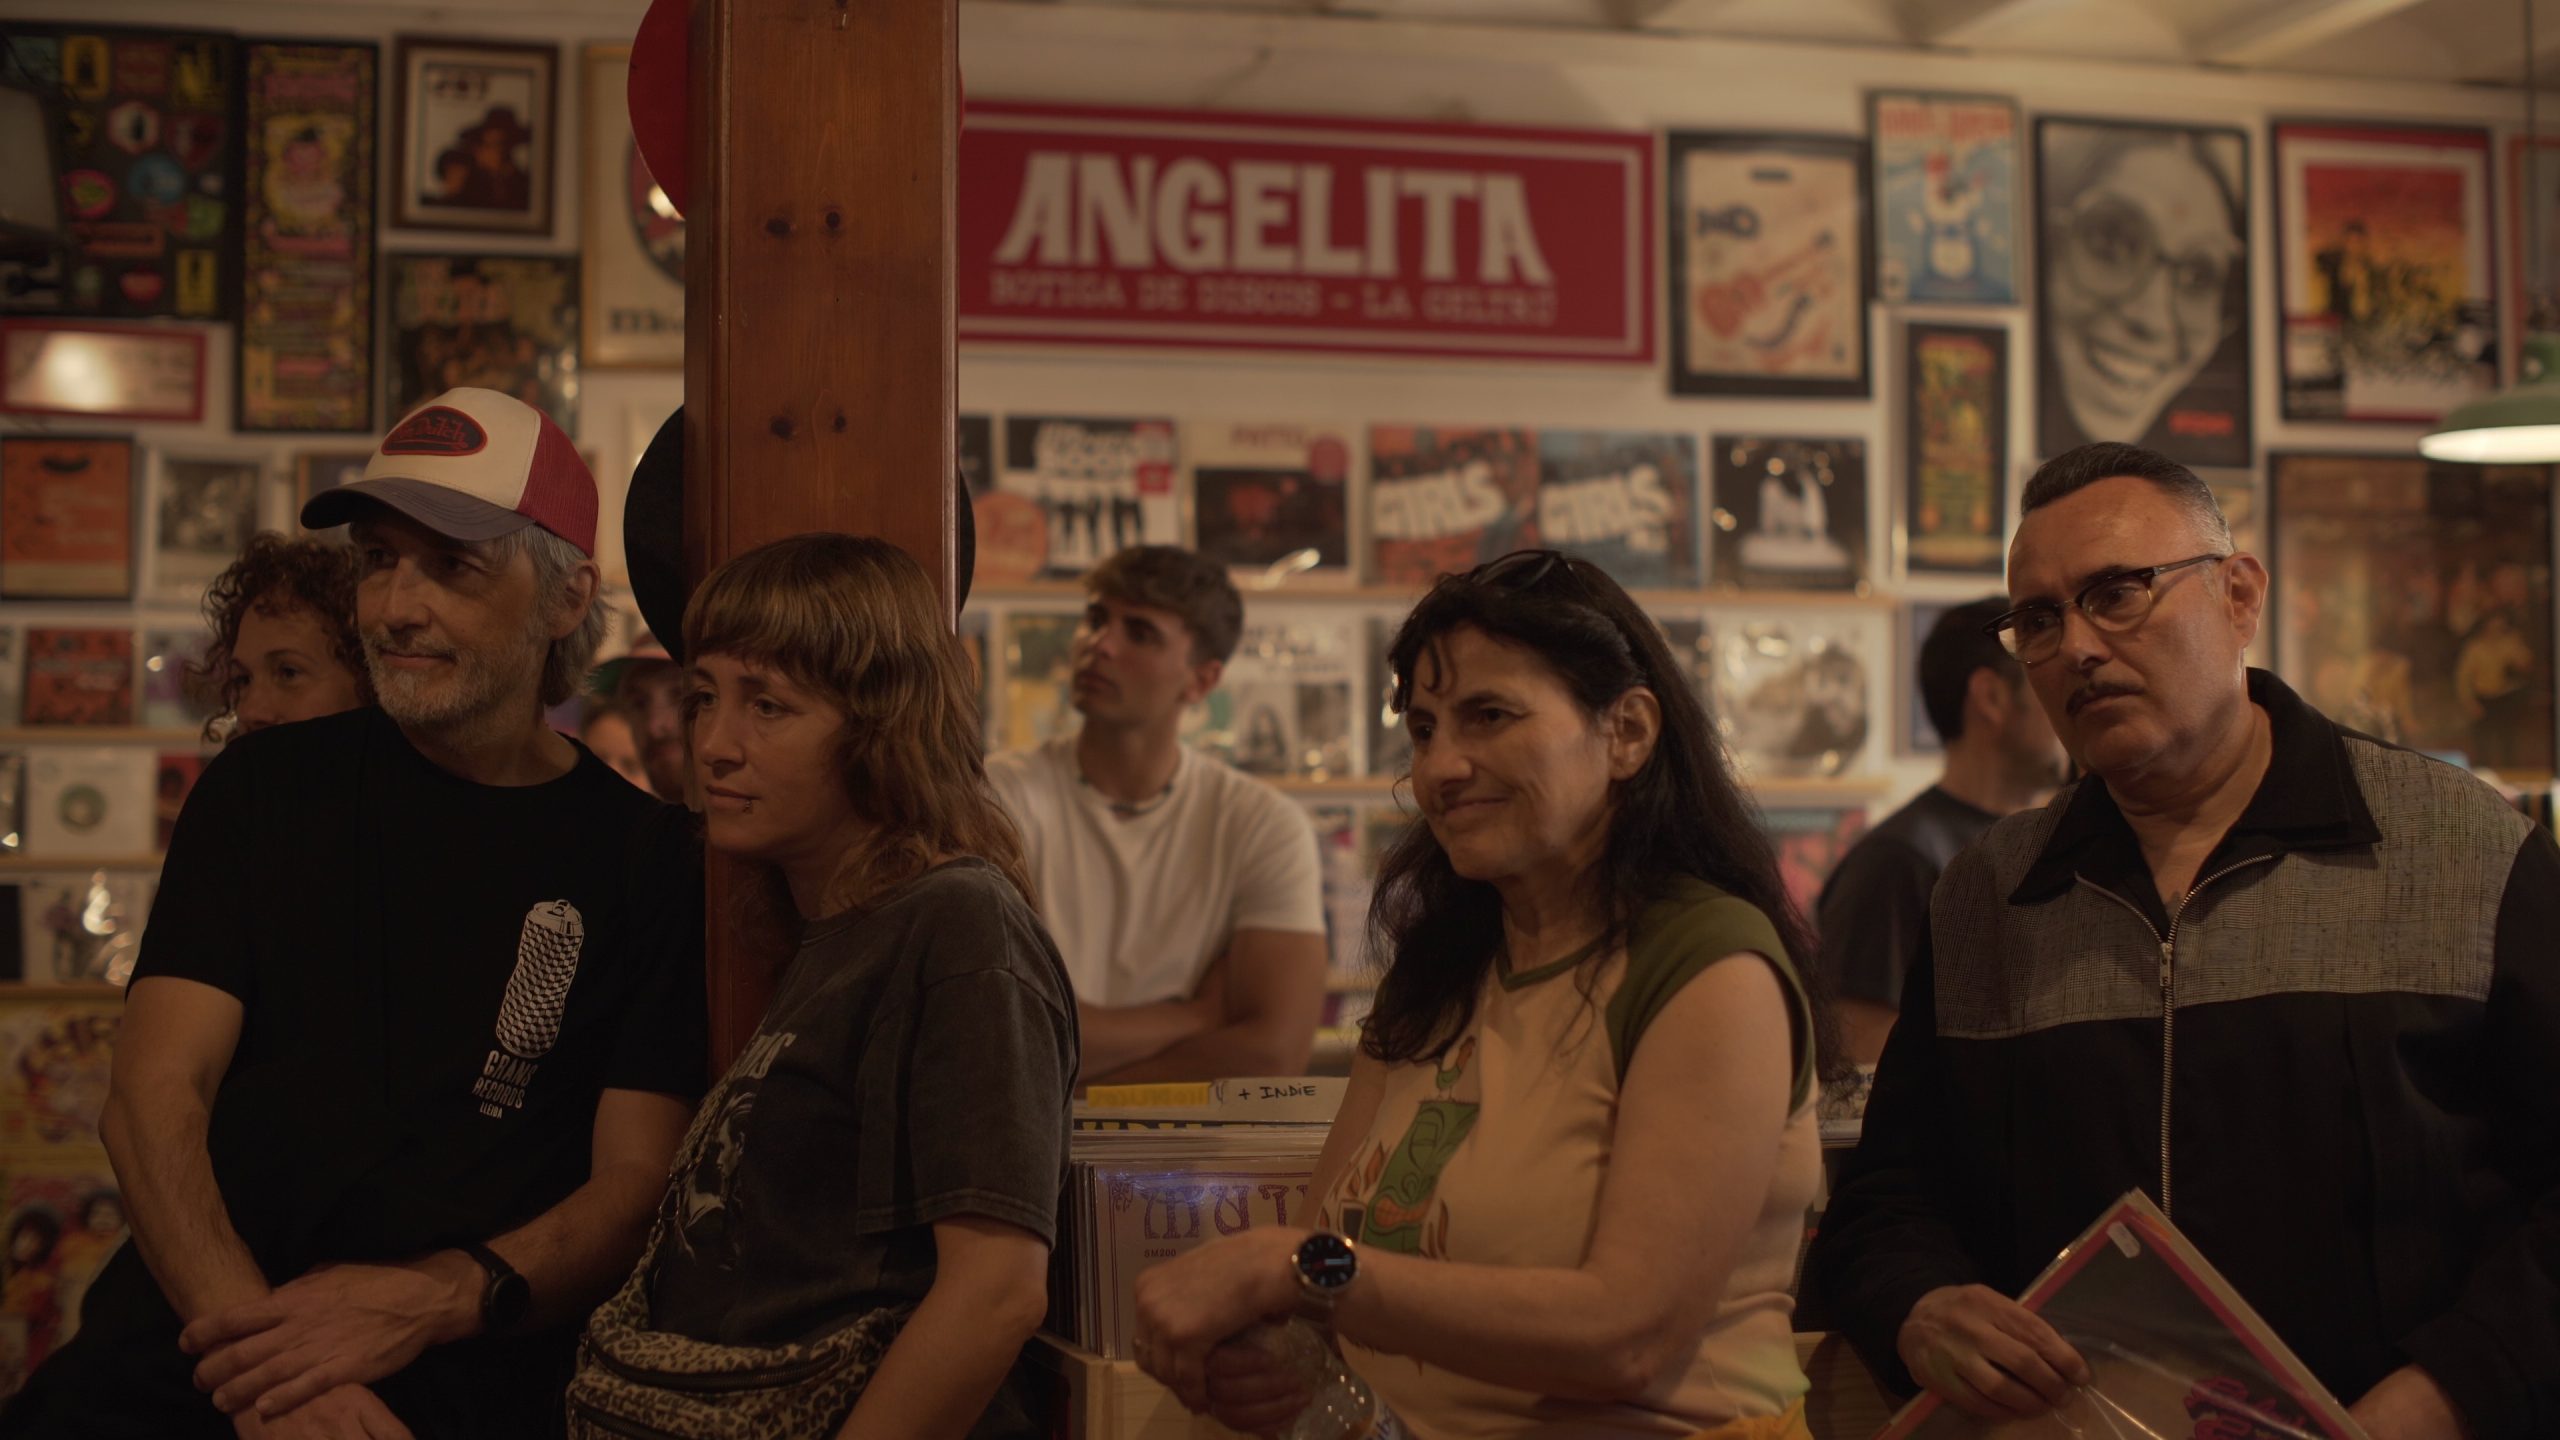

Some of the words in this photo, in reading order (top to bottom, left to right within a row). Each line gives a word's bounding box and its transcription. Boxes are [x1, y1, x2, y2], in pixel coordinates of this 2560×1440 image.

[991, 150, 1555, 286] ANGELITA
[1136, 275, 1188, 311] DE
[1360, 284, 1413, 319] LA
[1371, 458, 1505, 542] GIRLS
[1538, 462, 1671, 545] GIRLS
[471, 1076, 526, 1109] RECORDS
